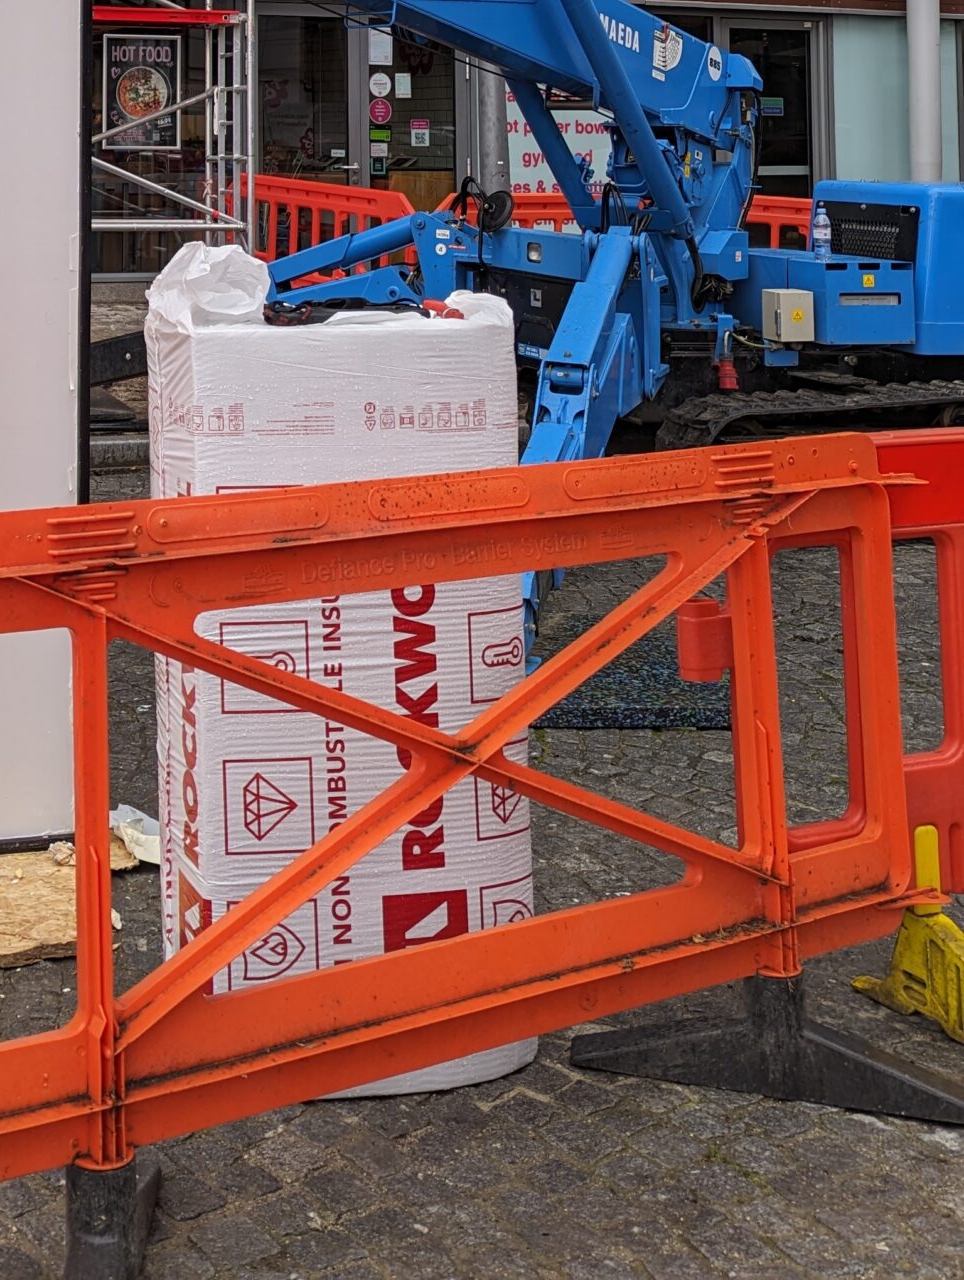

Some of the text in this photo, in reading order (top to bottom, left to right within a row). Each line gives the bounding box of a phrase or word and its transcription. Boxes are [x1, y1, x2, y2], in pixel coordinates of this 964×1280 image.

[599, 12, 640, 53] MAEDA
[111, 45, 172, 62] HOT FOOD
[301, 532, 588, 585] Defiance Pro Barrier System
